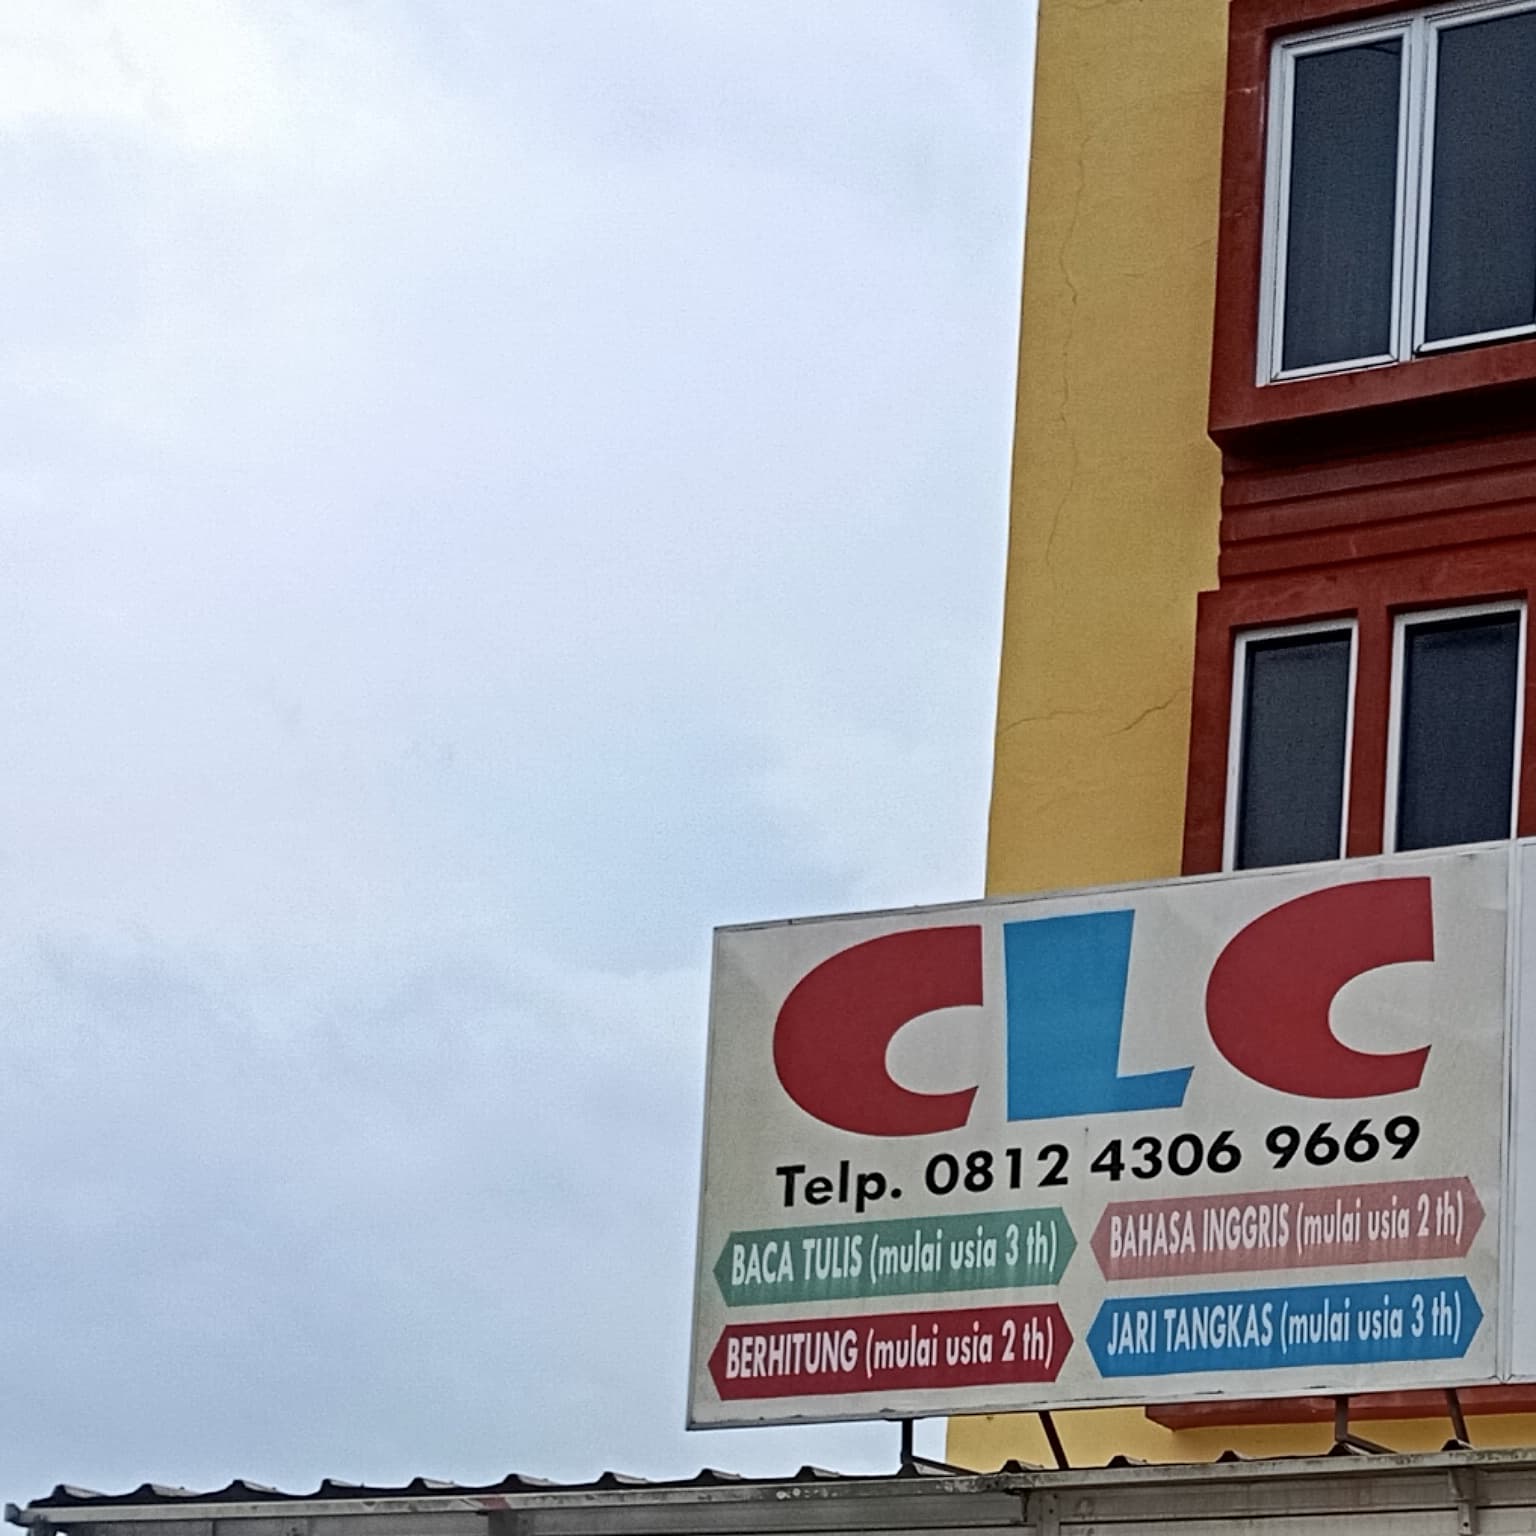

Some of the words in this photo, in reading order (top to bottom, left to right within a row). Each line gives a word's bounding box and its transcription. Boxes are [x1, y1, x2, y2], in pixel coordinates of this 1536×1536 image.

[773, 876, 1434, 1136] CLC
[776, 1160, 903, 1213] Telp.
[924, 1144, 1069, 1196] 0812
[1090, 1131, 1243, 1182] 4306
[1265, 1115, 1421, 1169] 9669
[731, 1241, 794, 1286] BACA
[803, 1235, 864, 1281] TULIS
[869, 1228, 943, 1284] (mulai
[949, 1225, 997, 1270] usia
[1005, 1223, 1020, 1265] 3
[1026, 1220, 1058, 1273] th)
[1110, 1210, 1196, 1258] BAHASA
[1203, 1202, 1290, 1251] INGGRIS
[1297, 1197, 1361, 1255] (mulai
[1367, 1195, 1410, 1241] usia
[1417, 1193, 1430, 1237] 2
[1436, 1190, 1464, 1244] th)
[725, 1329, 858, 1379] BERHITUNG
[865, 1323, 939, 1379] (mulai
[945, 1320, 993, 1366] usia
[1001, 1319, 1016, 1363] 2
[1022, 1315, 1053, 1370] th)
[1106, 1310, 1157, 1356] JARI
[1163, 1302, 1273, 1353] TANGKAS
[1280, 1298, 1351, 1355] (mulai
[1357, 1293, 1403, 1343] usia
[1411, 1293, 1425, 1339] 3
[1431, 1290, 1462, 1344] th)
